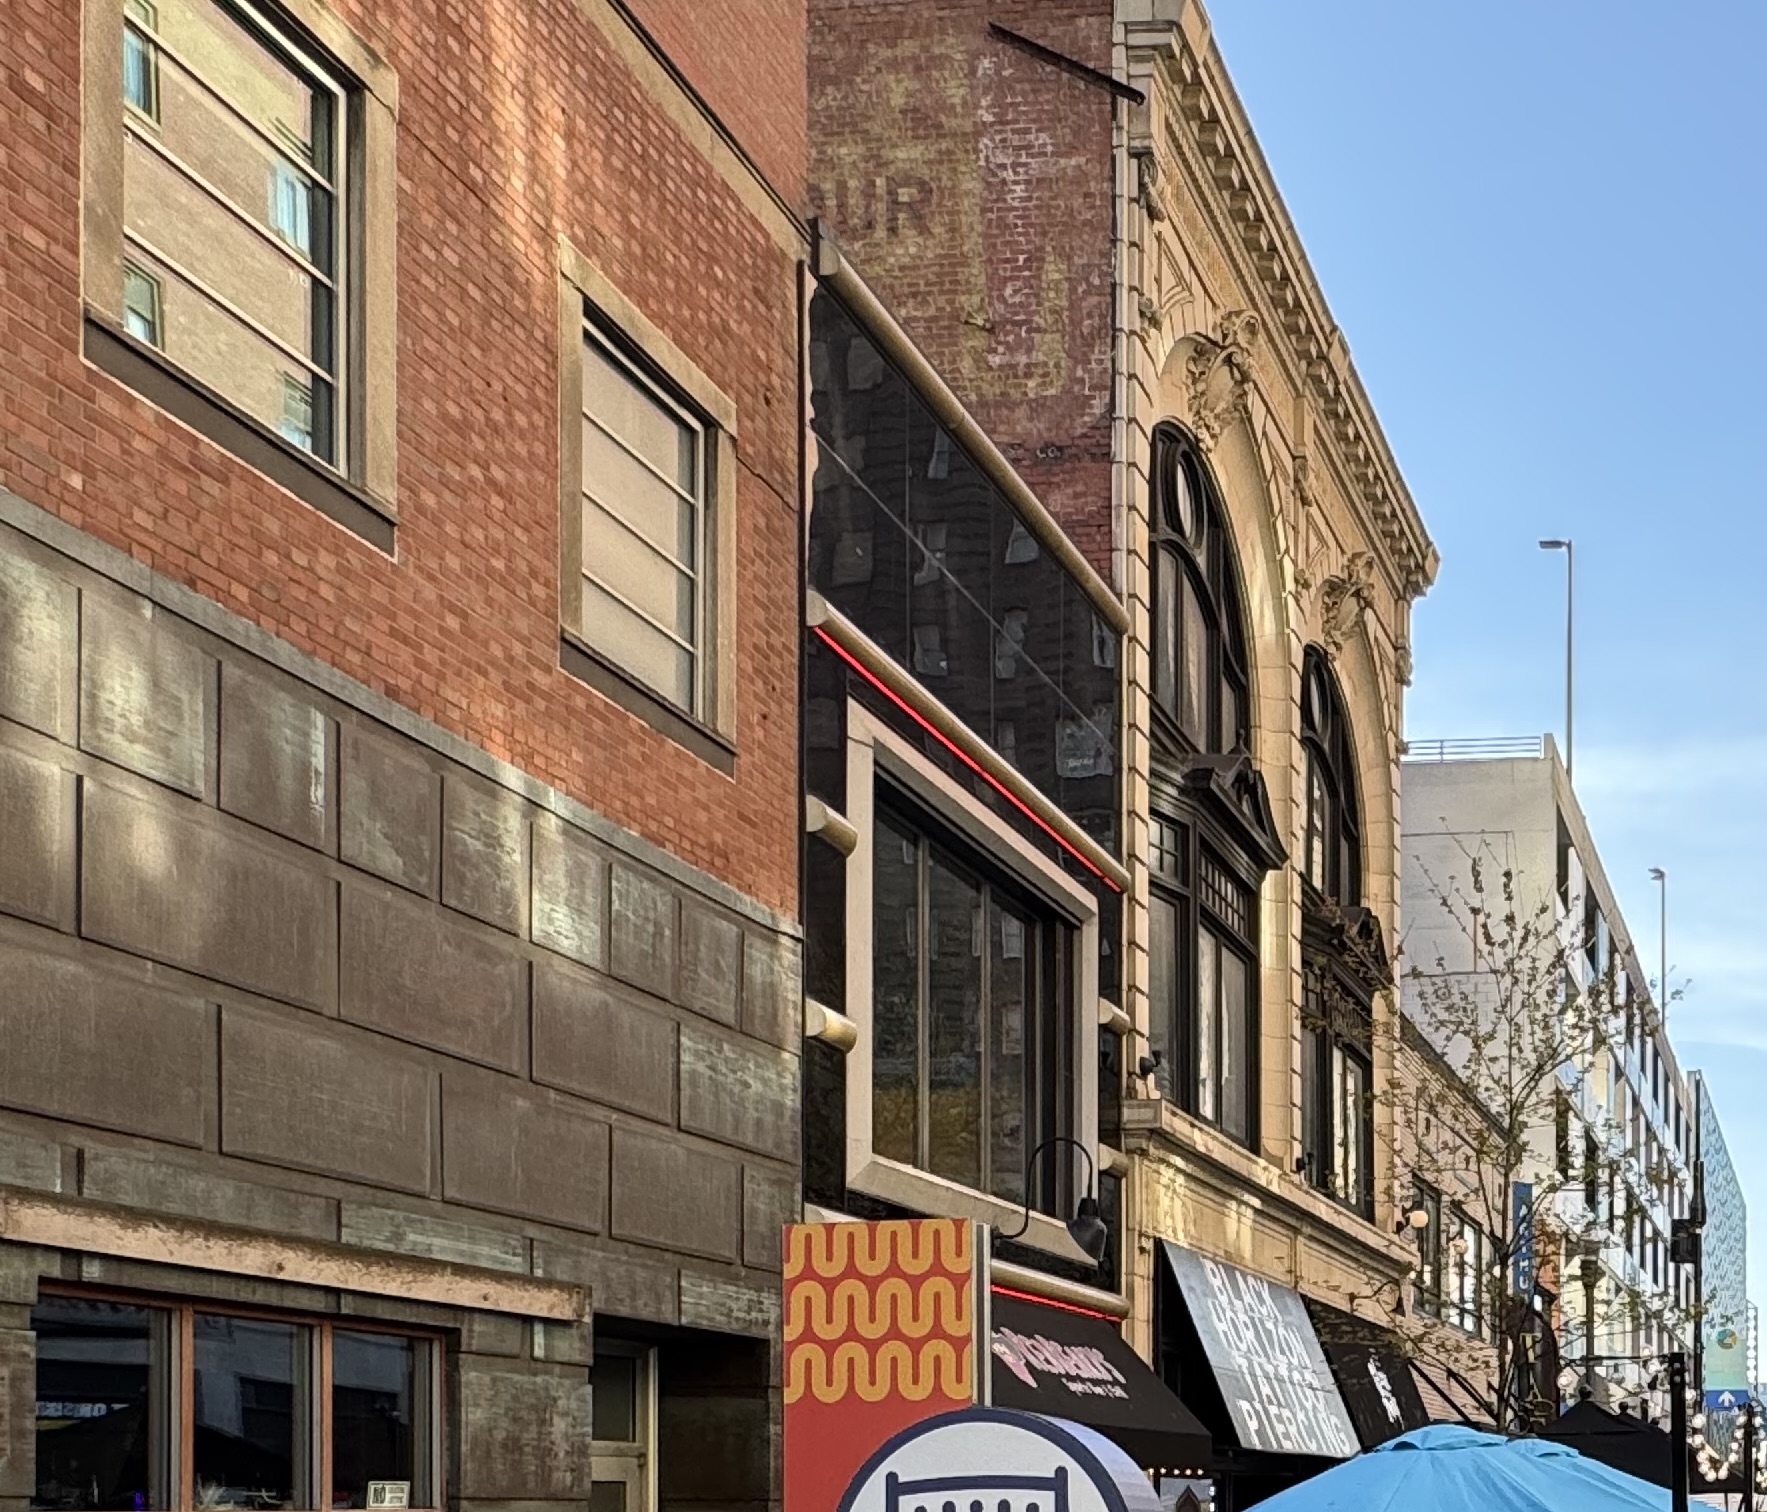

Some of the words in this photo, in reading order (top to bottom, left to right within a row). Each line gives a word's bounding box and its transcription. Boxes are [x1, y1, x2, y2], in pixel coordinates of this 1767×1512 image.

[1201, 1258, 1284, 1324] BLACK
[1208, 1299, 1313, 1375] HORIZON
[1231, 1351, 1330, 1417] TATTOO
[1237, 1399, 1351, 1455] PIERCING
